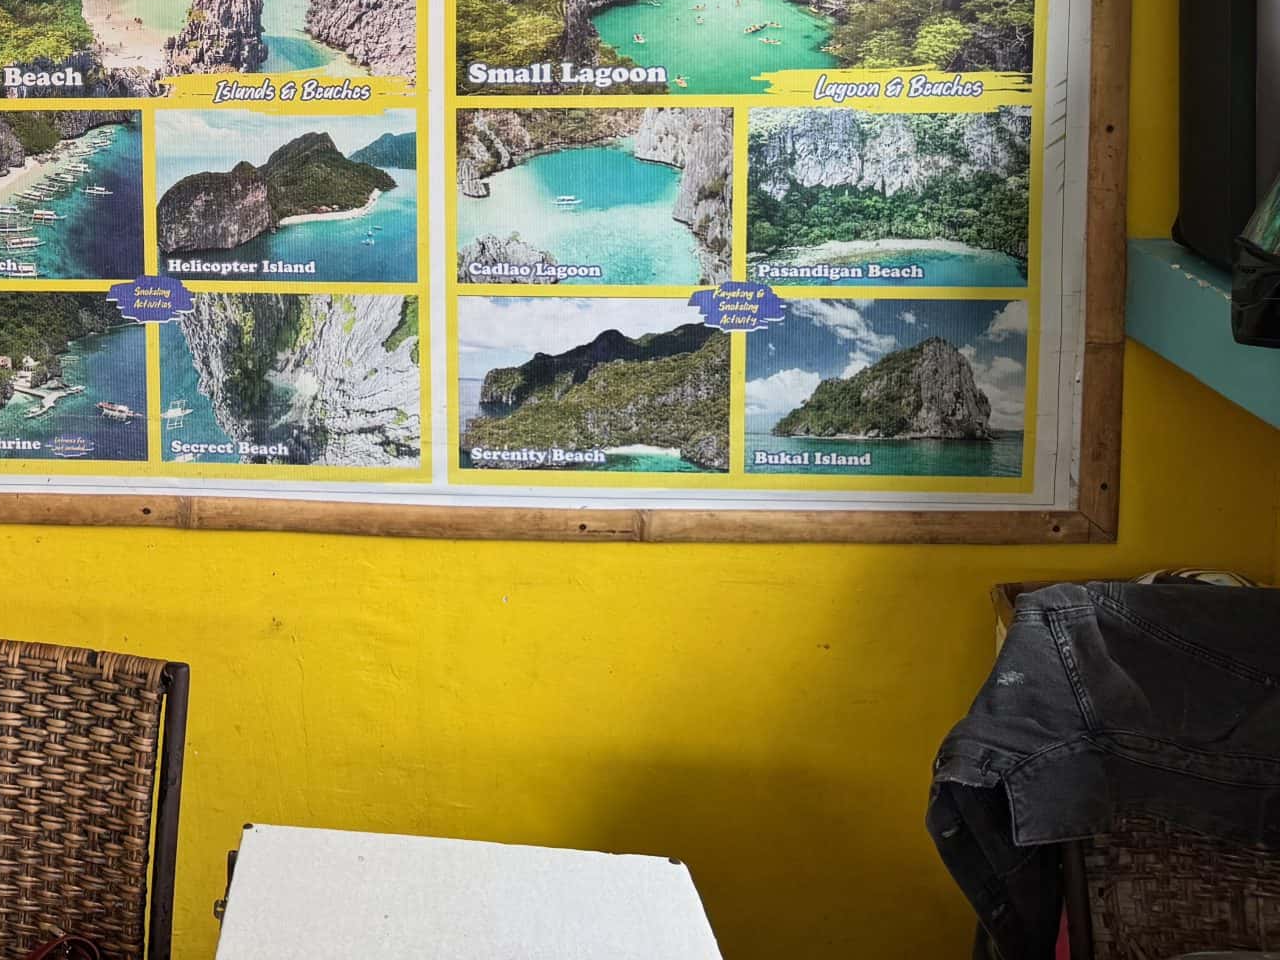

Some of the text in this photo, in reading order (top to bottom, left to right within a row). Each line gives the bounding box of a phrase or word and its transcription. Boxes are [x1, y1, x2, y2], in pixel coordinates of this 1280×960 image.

[4, 67, 84, 88] Beach
[468, 63, 668, 87] Small Lagoon
[213, 78, 371, 103] Islands & Beaches
[814, 74, 983, 103] Lagoon & Beaches
[167, 259, 316, 276] Helicopter Island
[468, 262, 601, 279] Cadlao Lagoon
[757, 264, 924, 281] Pasandigan Beach
[713, 287, 753, 300] Kayaking
[133, 299, 172, 310] Activities
[720, 314, 757, 326] Activity
[238, 441, 289, 455] Beach
[471, 447, 606, 463] Serenity Beach
[754, 451, 871, 466] Bukal Island
